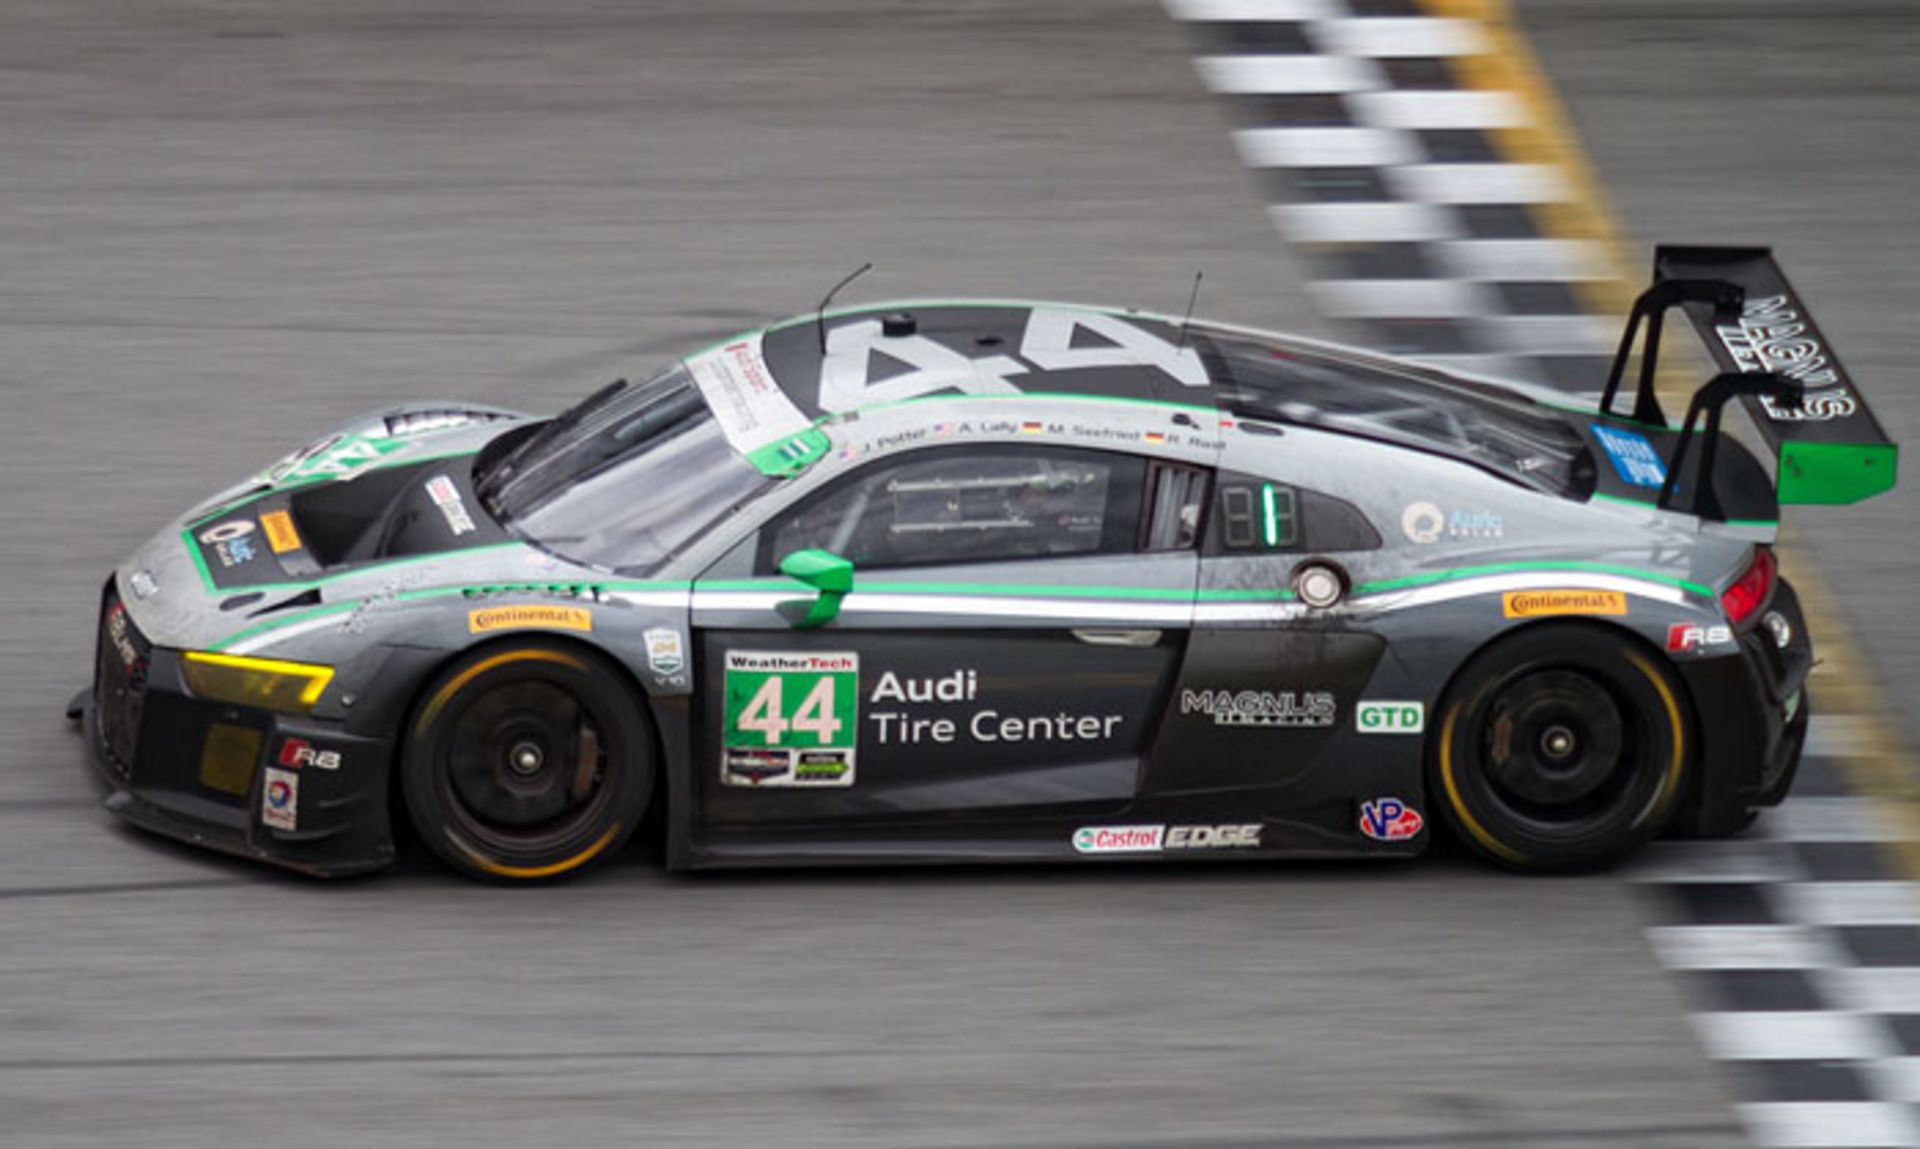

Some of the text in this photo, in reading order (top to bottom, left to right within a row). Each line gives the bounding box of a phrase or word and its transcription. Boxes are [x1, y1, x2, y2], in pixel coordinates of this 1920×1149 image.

[819, 307, 1211, 413] 44
[1510, 593, 1604, 614] Continental
[475, 607, 569, 626] Continental
[1682, 626, 1731, 647] R8
[731, 657, 853, 668] WeatherTech
[870, 670, 976, 703] Audi
[737, 675, 843, 745] 44
[1181, 690, 1336, 715] MAGNUS
[869, 710, 1122, 743] Tire Center
[1360, 706, 1420, 727] GTD
[293, 747, 341, 769] R8
[1362, 799, 1404, 838] VP
[1097, 824, 1262, 848] Castrol EDGE
